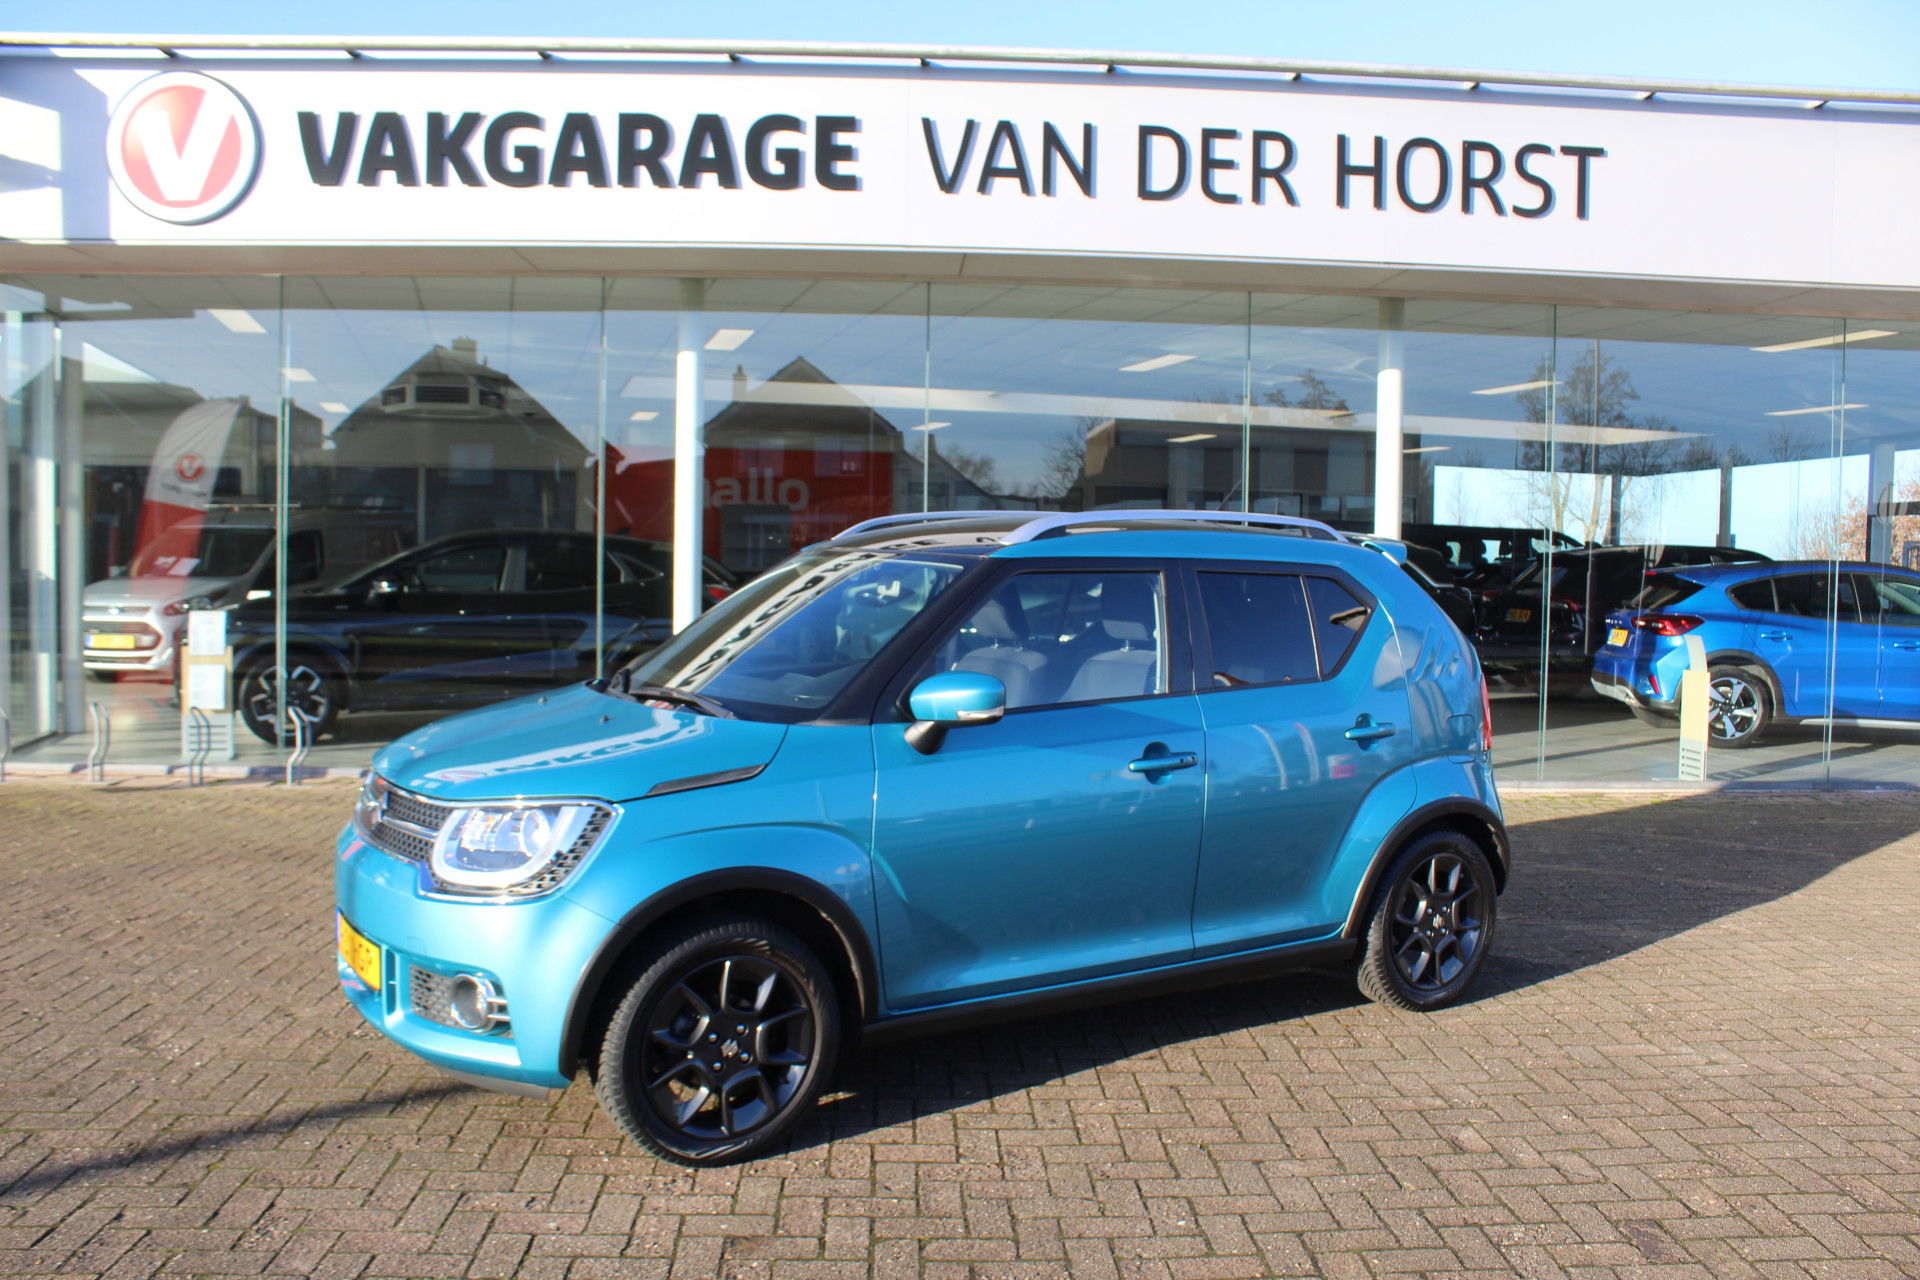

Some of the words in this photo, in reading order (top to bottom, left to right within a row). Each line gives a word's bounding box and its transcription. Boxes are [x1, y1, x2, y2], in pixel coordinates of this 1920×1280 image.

[297, 111, 862, 191] VAKGARAGE
[921, 117, 1097, 199] VAN
[1137, 123, 1300, 208] DER
[1335, 133, 1607, 221] HORST
